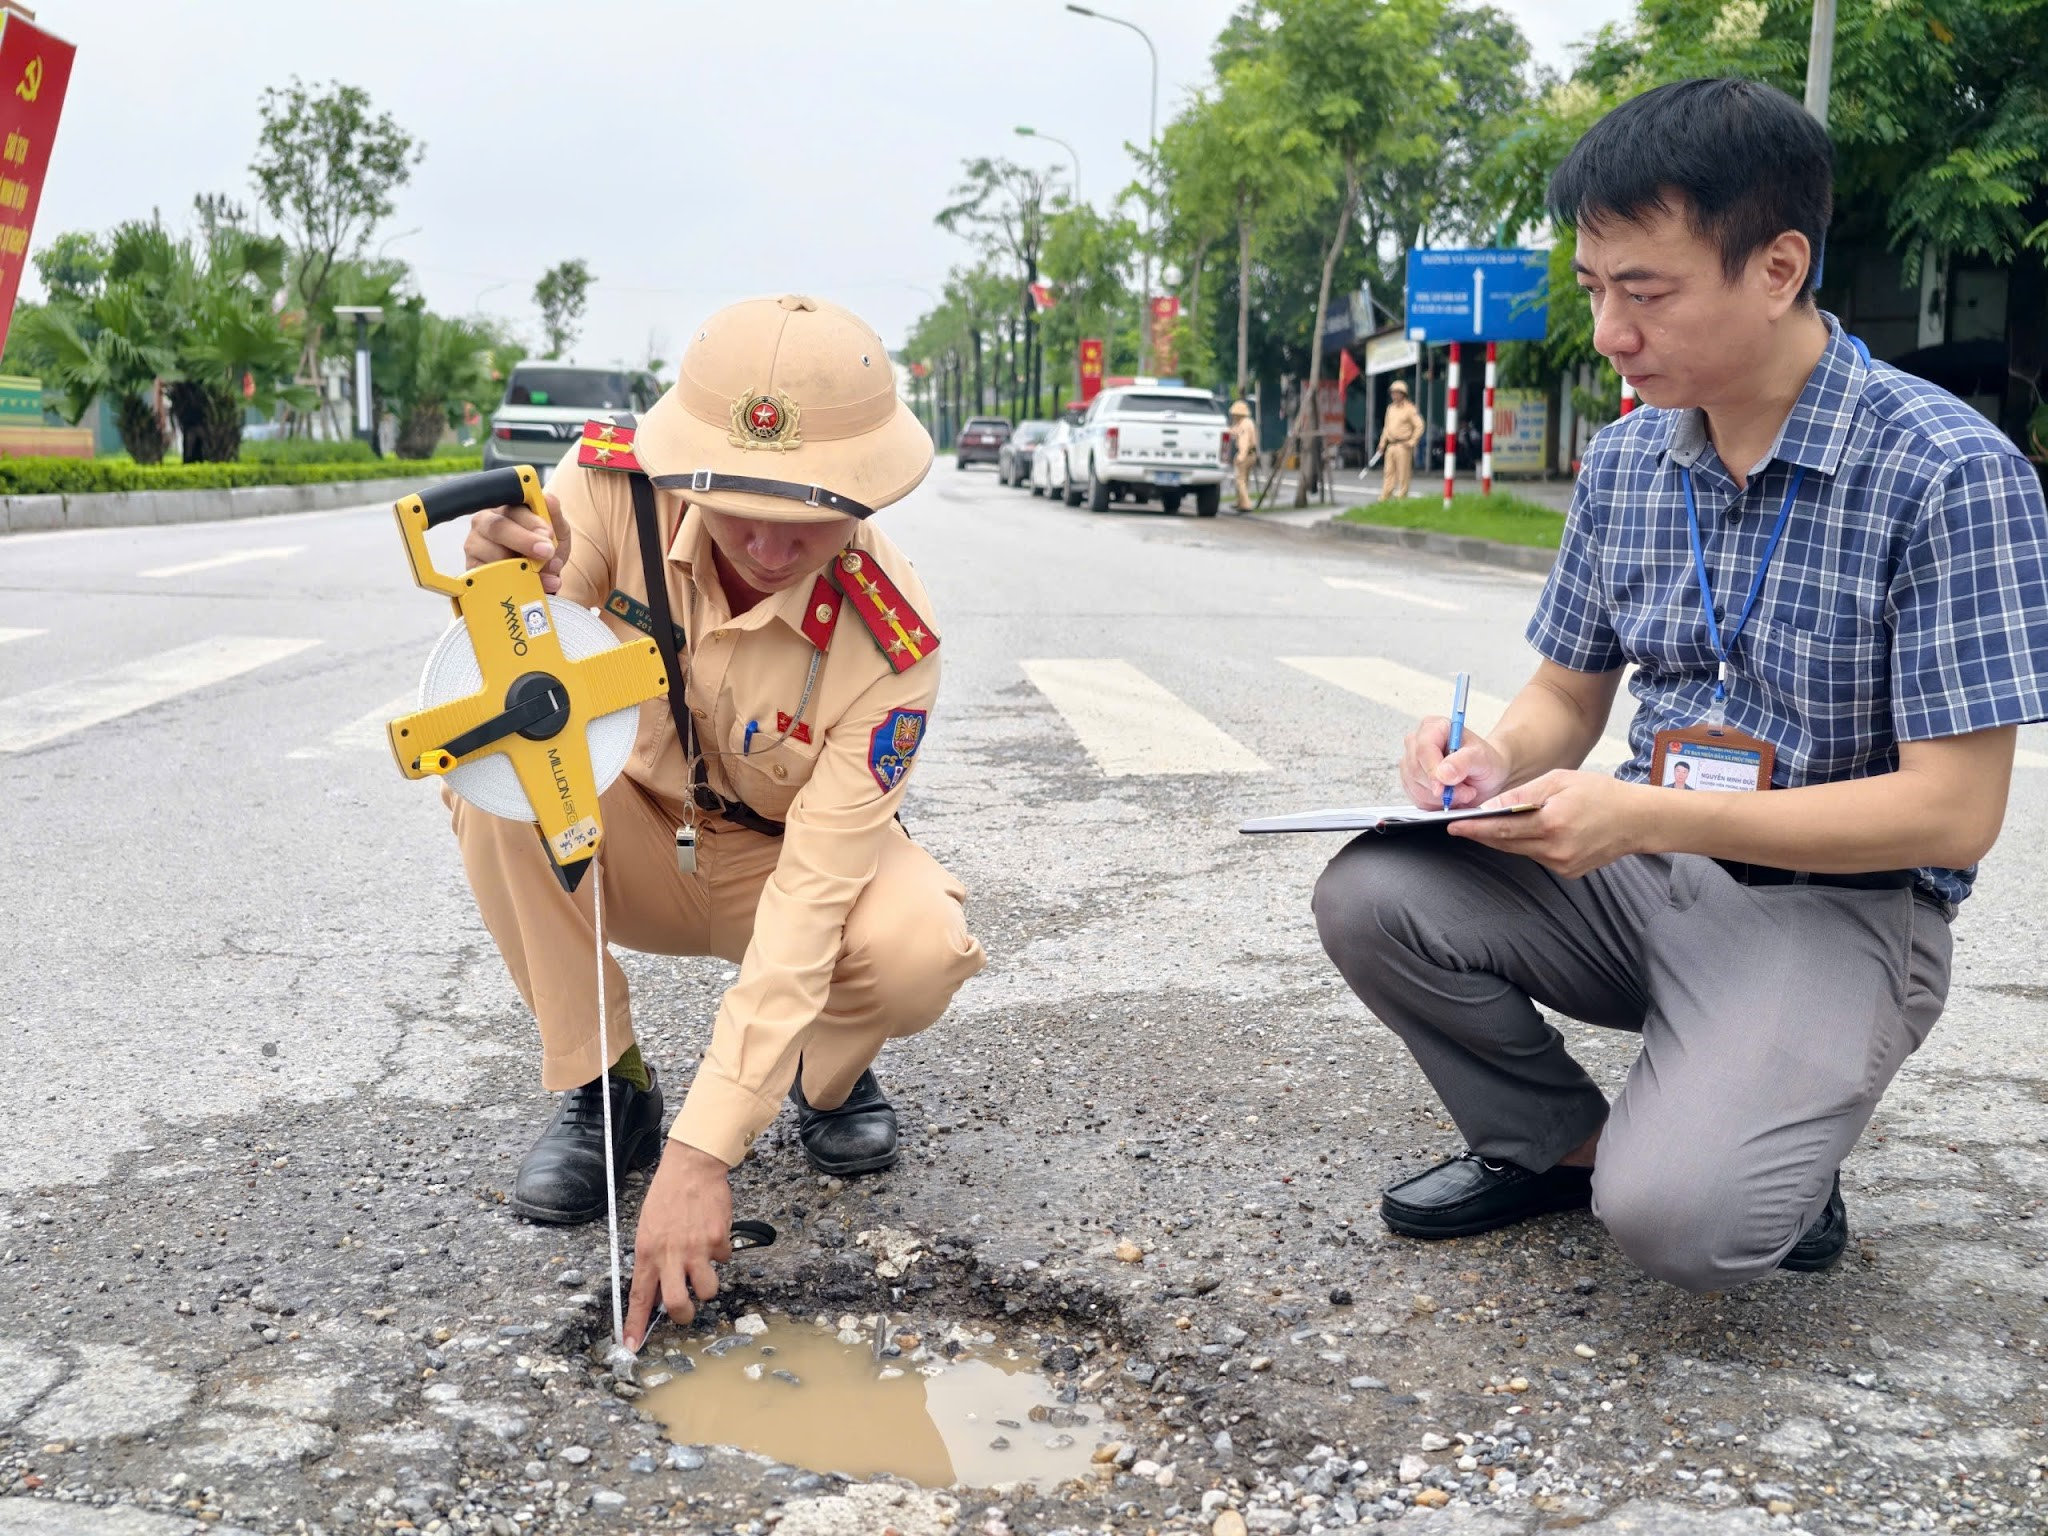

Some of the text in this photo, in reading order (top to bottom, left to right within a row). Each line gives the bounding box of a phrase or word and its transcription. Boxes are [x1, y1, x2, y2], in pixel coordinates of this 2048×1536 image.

[500, 596, 528, 657] YAMAYO
[547, 748, 579, 827] MILLION 50
[1701, 772, 1725, 781] NGUYỄN
[1742, 778, 1755, 786] ĐỨC
